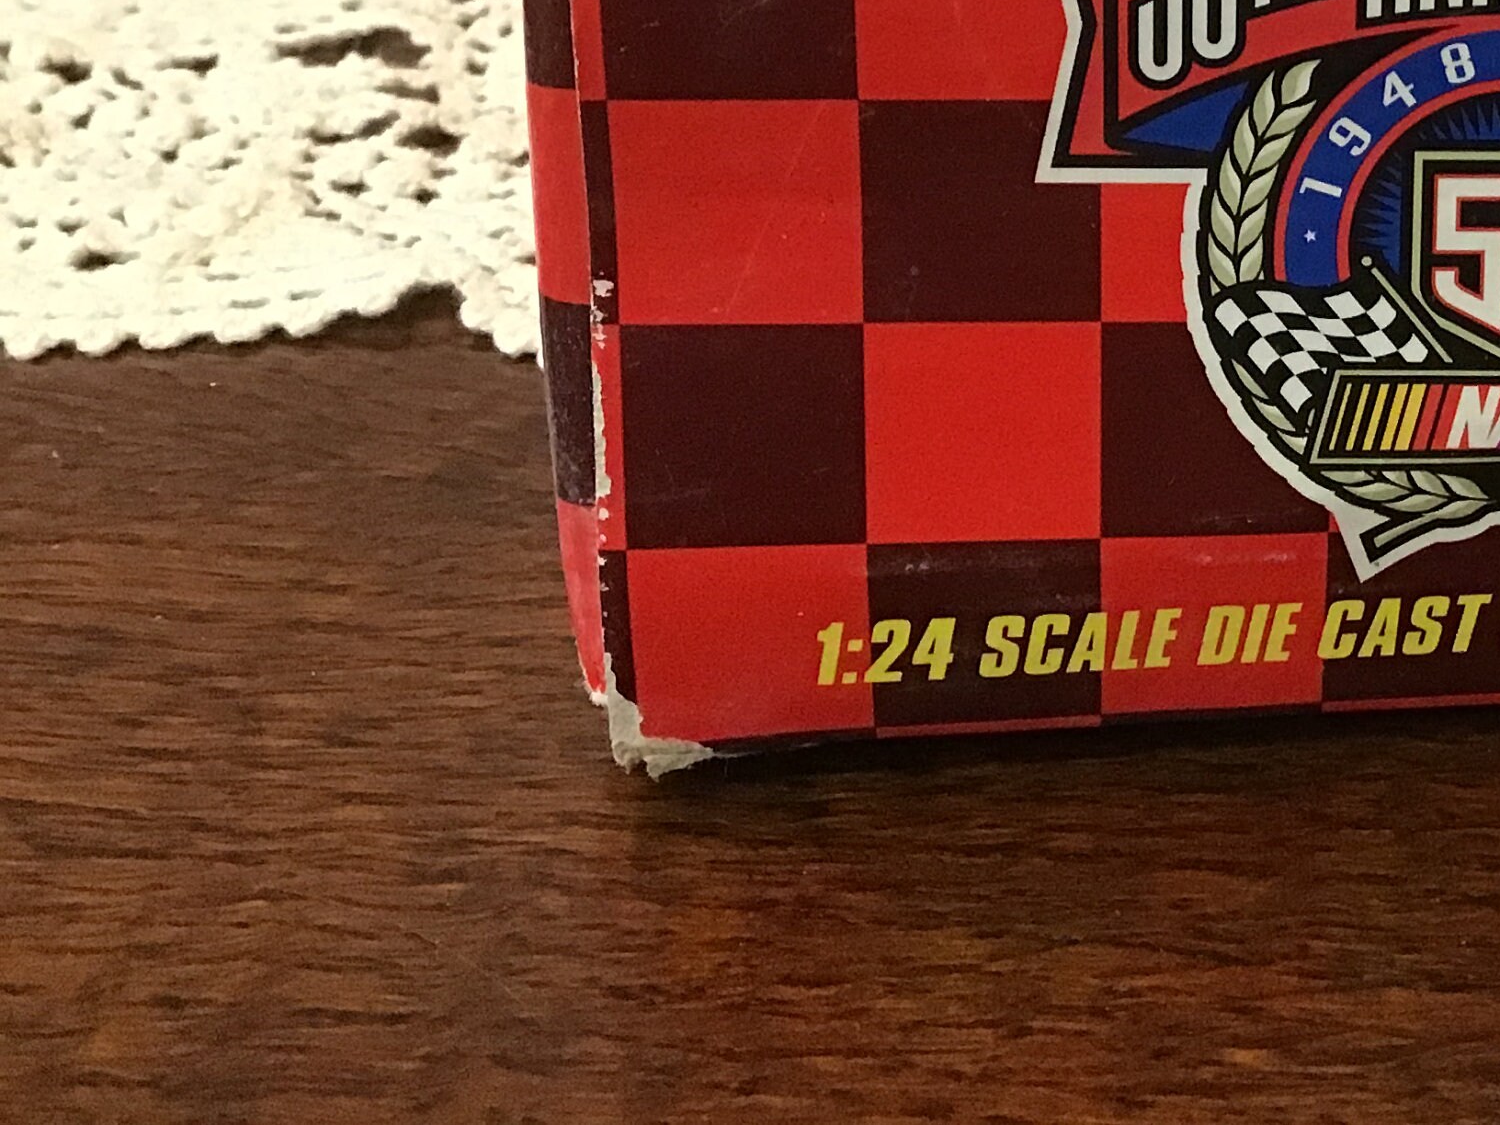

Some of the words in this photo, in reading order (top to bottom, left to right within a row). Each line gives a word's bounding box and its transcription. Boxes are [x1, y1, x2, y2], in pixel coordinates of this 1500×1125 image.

[1299, 42, 1476, 198] 1948
[816, 618, 957, 686] 1:24
[979, 609, 1182, 678] SCALE
[1198, 602, 1302, 665] DIE
[1317, 594, 1492, 659] CAST
